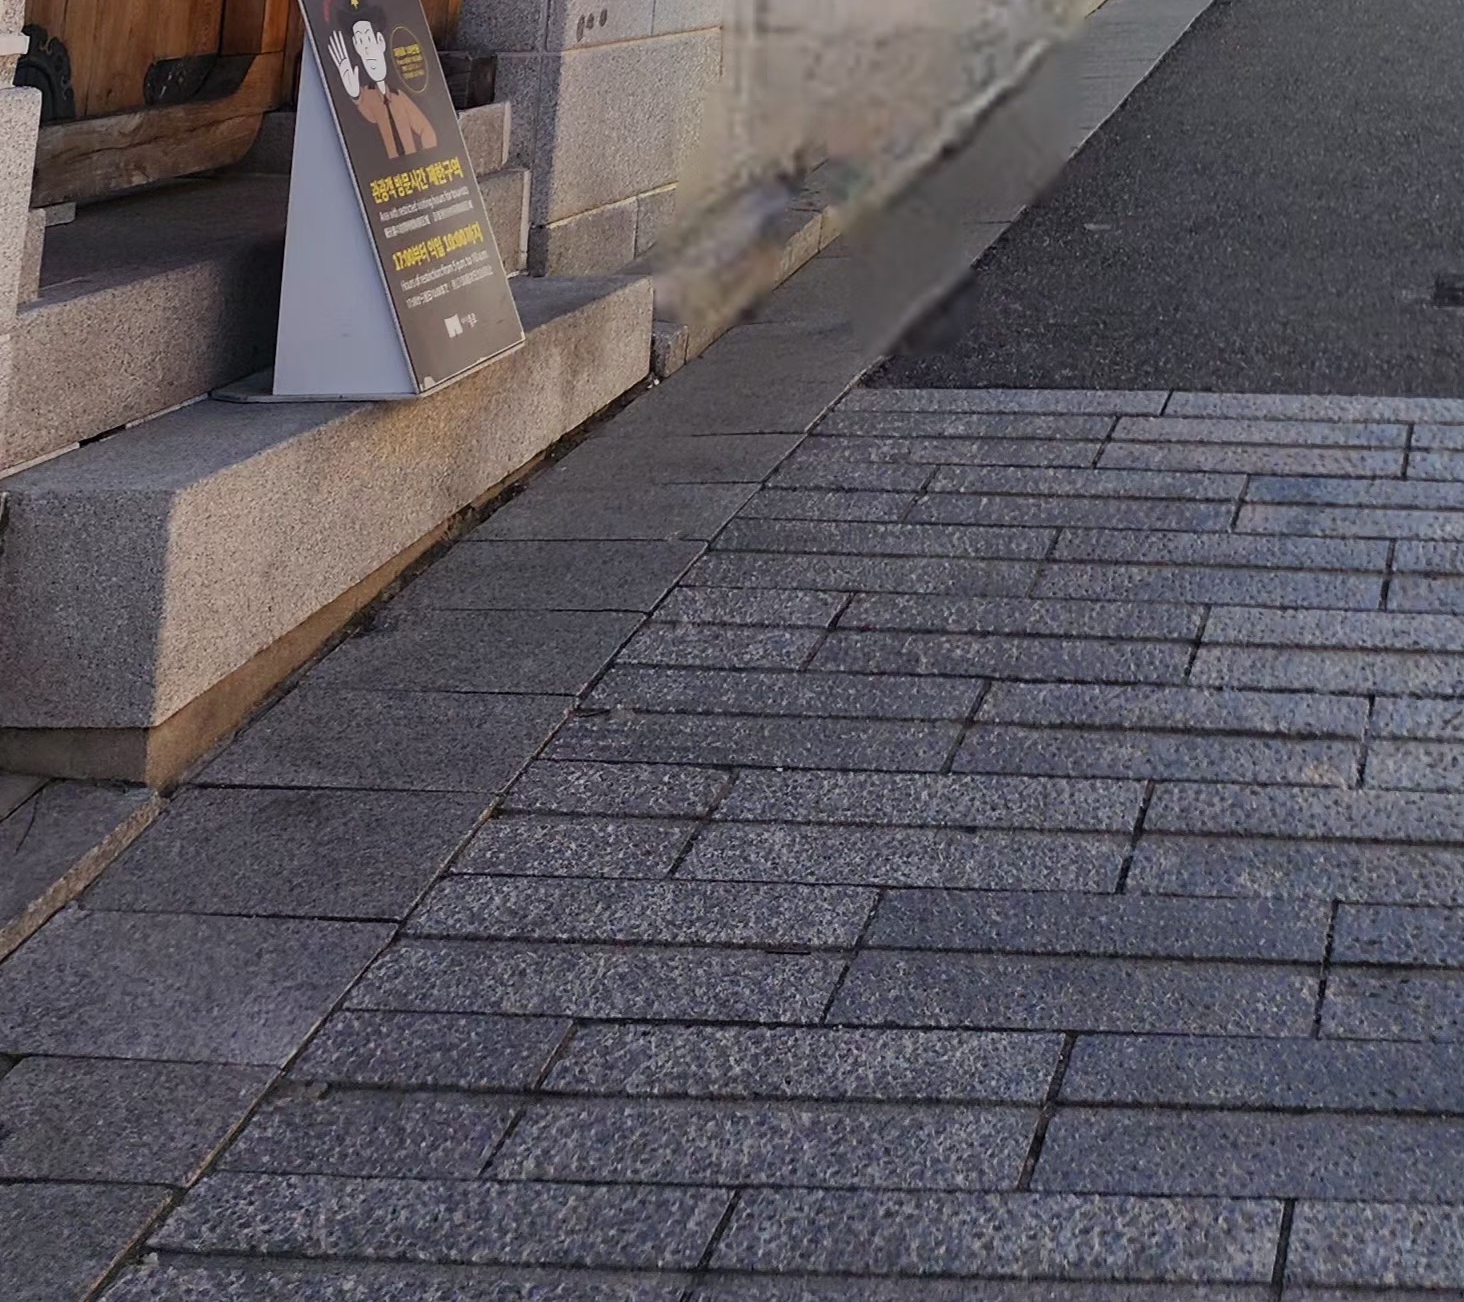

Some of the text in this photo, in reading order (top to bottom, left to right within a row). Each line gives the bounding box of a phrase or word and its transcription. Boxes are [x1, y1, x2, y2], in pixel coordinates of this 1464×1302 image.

[370, 156, 464, 204] 관광객 방문시간 제한구역
